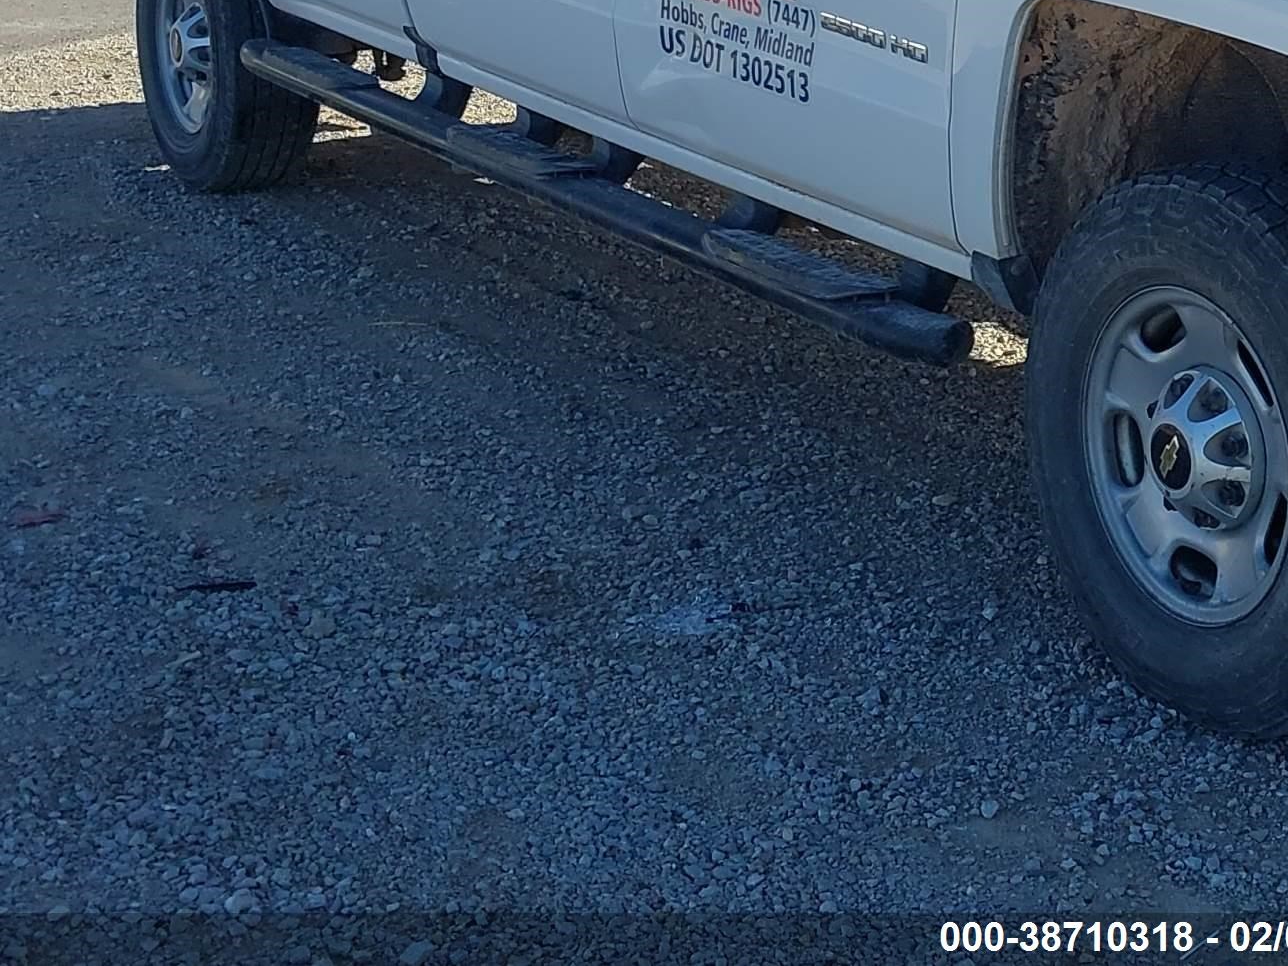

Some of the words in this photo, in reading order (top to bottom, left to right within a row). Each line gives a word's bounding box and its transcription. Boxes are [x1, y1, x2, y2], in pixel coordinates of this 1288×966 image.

[660, 26, 686, 56] US
[689, 32, 725, 72] DOT
[730, 48, 810, 103] 1302513
[711, 12, 750, 48] Crane,
[754, 28, 815, 68] Midland
